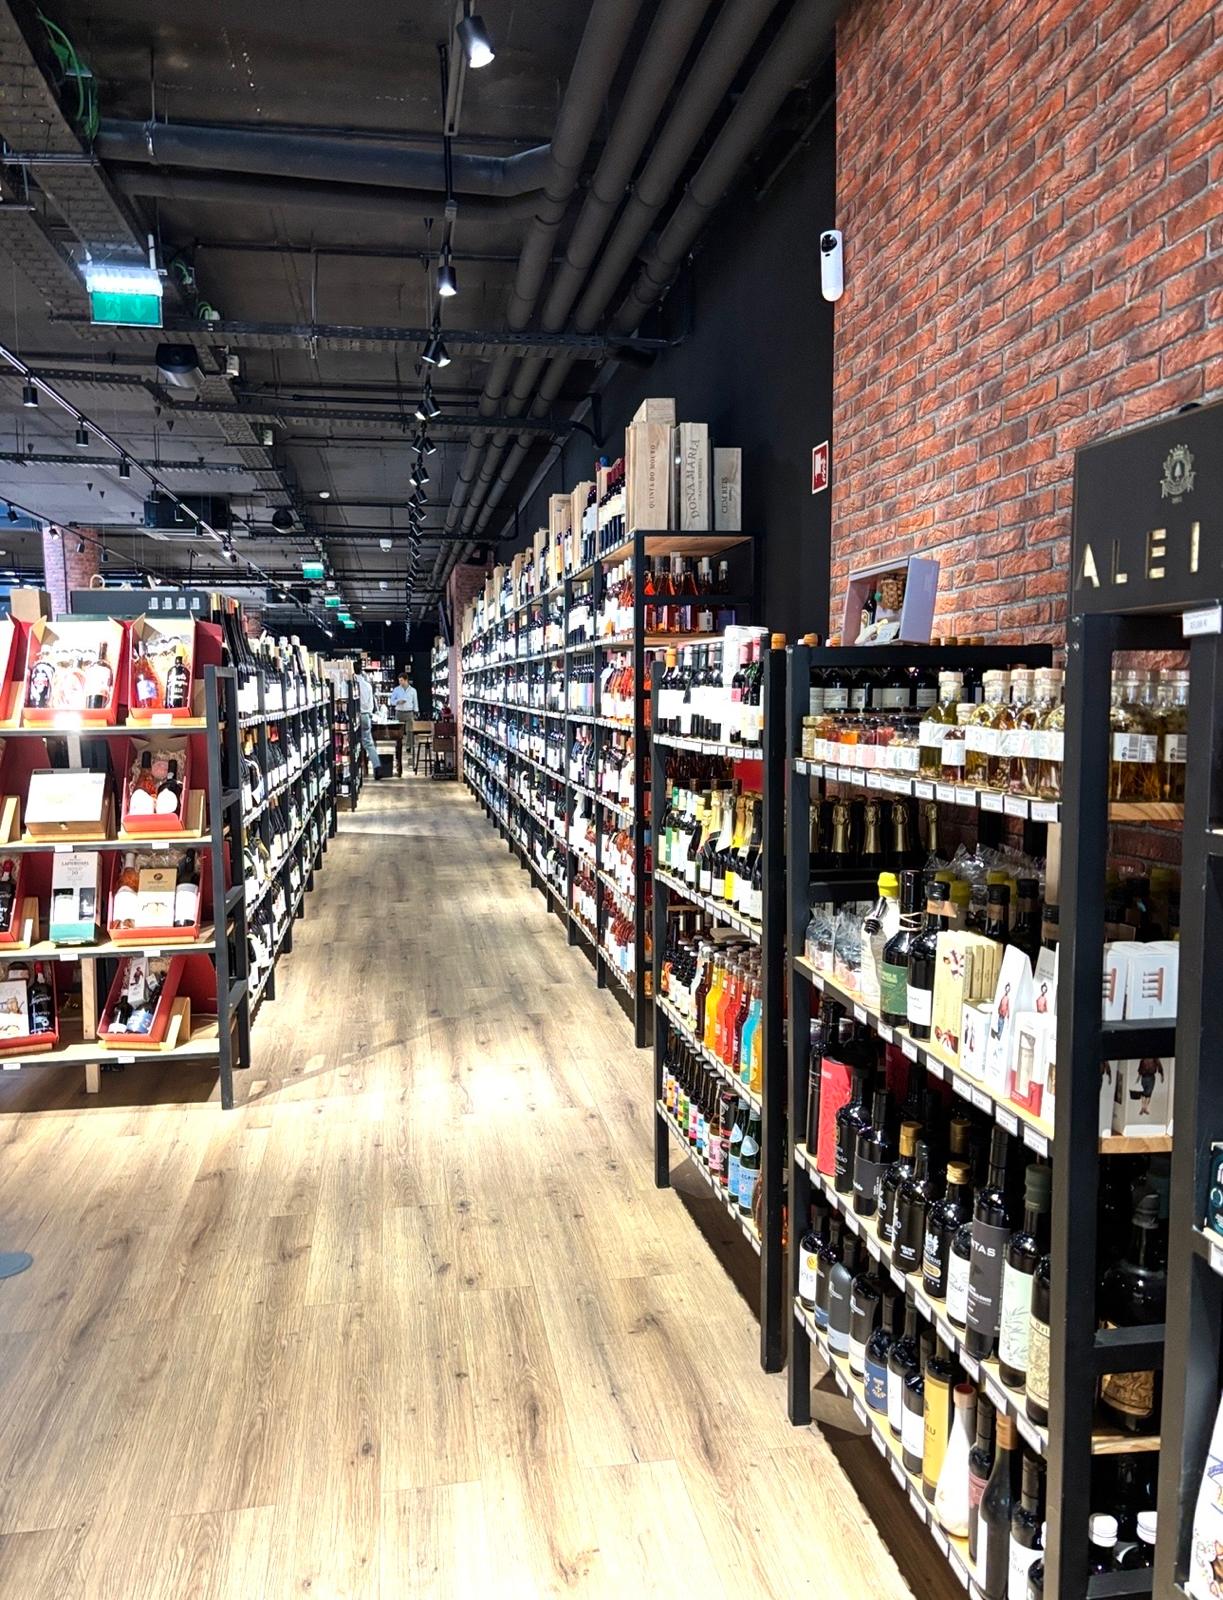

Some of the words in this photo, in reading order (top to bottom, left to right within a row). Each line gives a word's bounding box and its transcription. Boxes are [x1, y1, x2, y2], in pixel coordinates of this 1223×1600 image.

[685, 439, 700, 482] MARIA
[685, 483, 700, 520] DONA
[1074, 521, 1223, 591] ALEI
